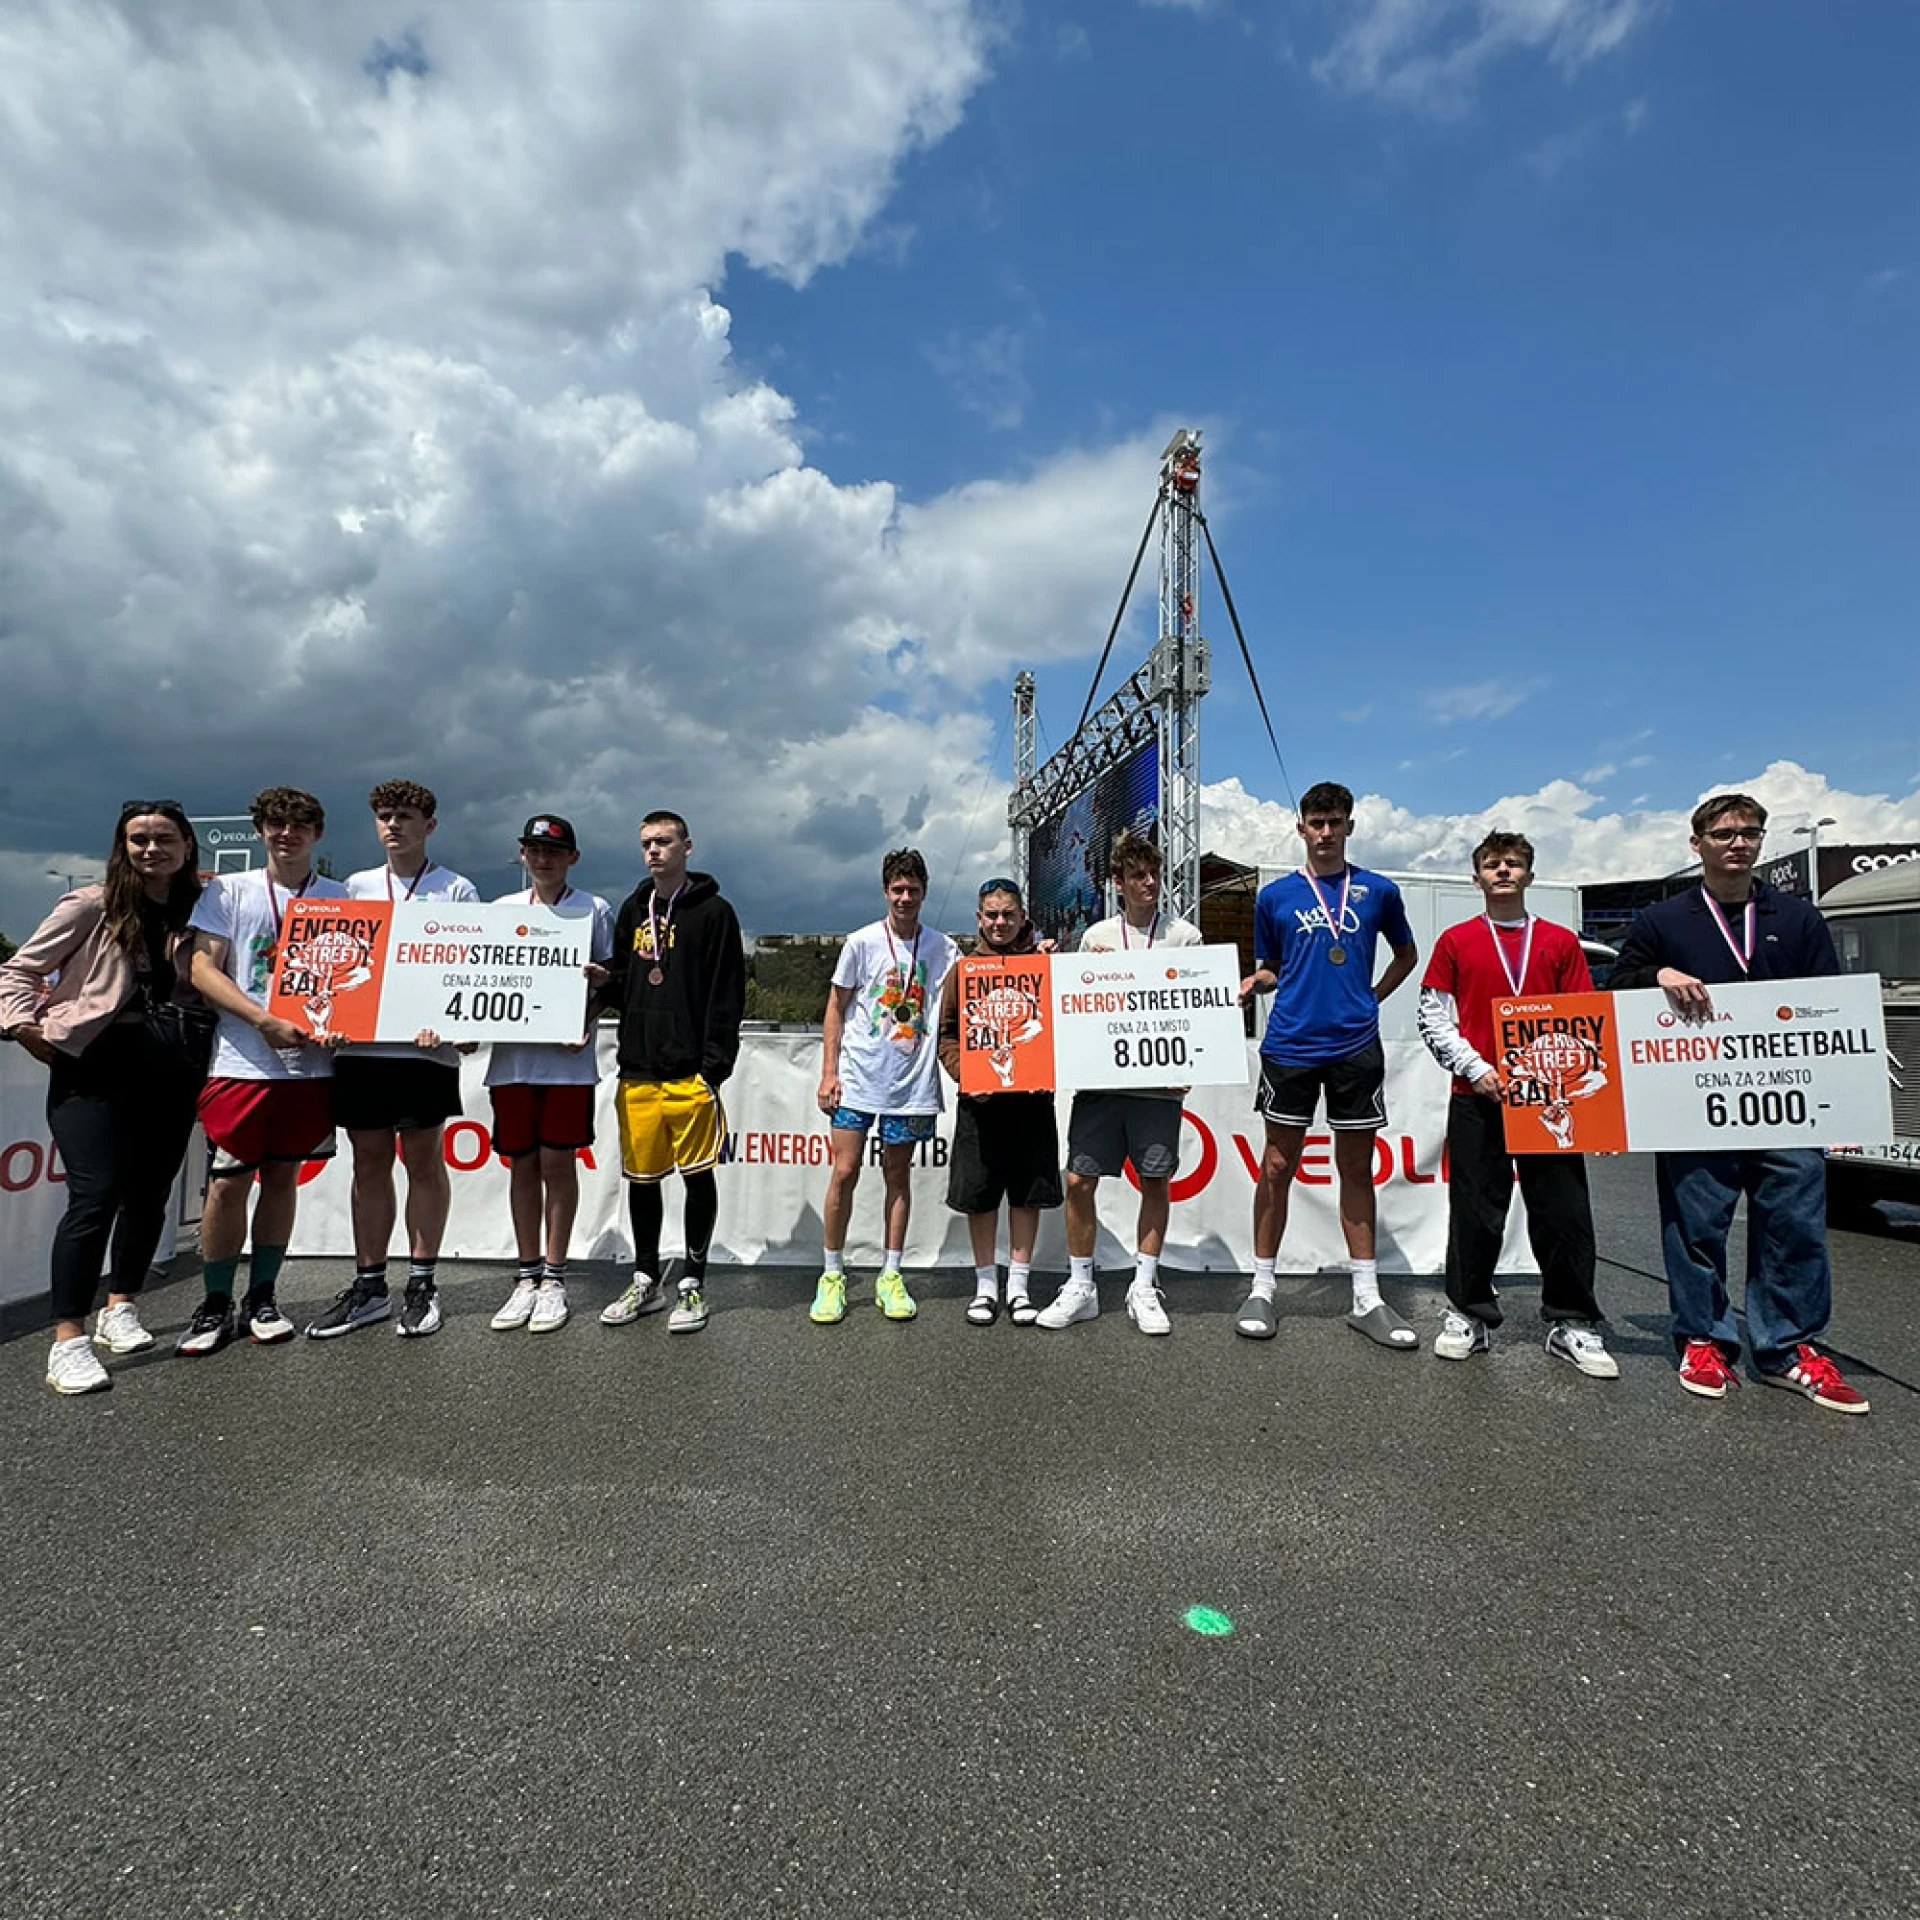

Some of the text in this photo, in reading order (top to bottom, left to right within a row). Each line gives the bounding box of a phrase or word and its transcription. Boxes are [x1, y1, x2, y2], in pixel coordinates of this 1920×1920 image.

[441, 924, 483, 934] VEOLIA
[396, 943, 582, 967] ENERGYSTREETBALL
[442, 973, 471, 988] CENA
[473, 973, 488, 988] ZA
[1096, 972, 1136, 982] VEOLIA
[445, 991, 542, 1024] 4.000,-
[1061, 987, 1236, 1014] ENERGYSTREETBALL
[1107, 1020, 1133, 1035] CENA
[1136, 1020, 1150, 1034] ZA
[1114, 1036, 1204, 1067] 8.000,-
[1630, 1028, 1876, 1064] ENERGYSTREETBALL
[1695, 1073, 1732, 1088] CENA
[1735, 1071, 1754, 1087] ZA
[1706, 1090, 1831, 1128] 6.000,-
